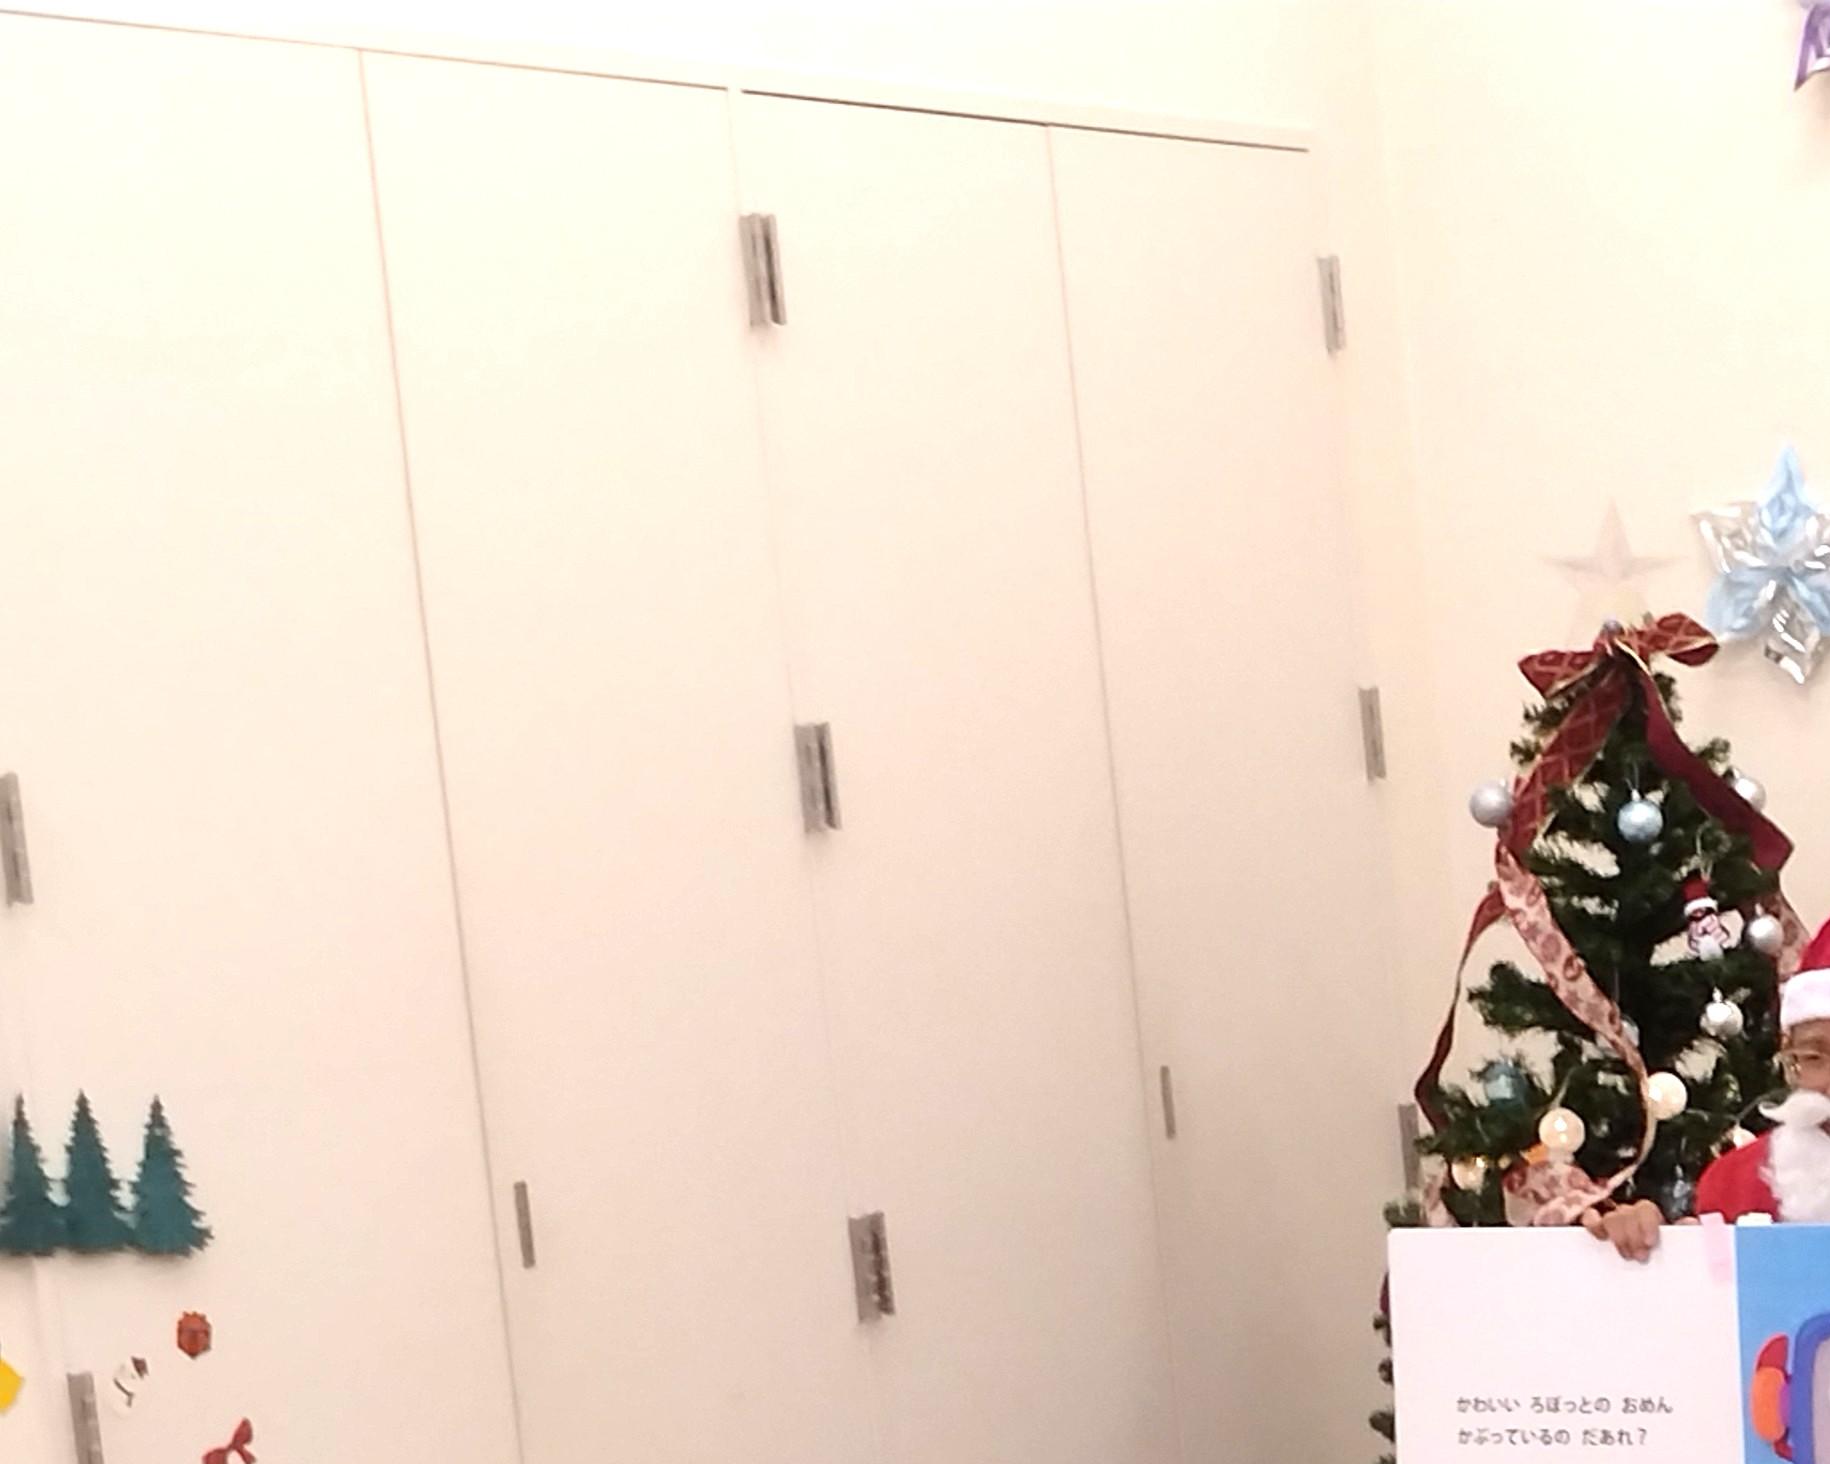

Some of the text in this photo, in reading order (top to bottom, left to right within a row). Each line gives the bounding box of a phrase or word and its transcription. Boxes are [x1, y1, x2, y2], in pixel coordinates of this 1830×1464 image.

[1456, 1396, 1521, 1413] かわいい
[1621, 1396, 1674, 1414] おめん
[1457, 1427, 1571, 1445] かぶっているの
